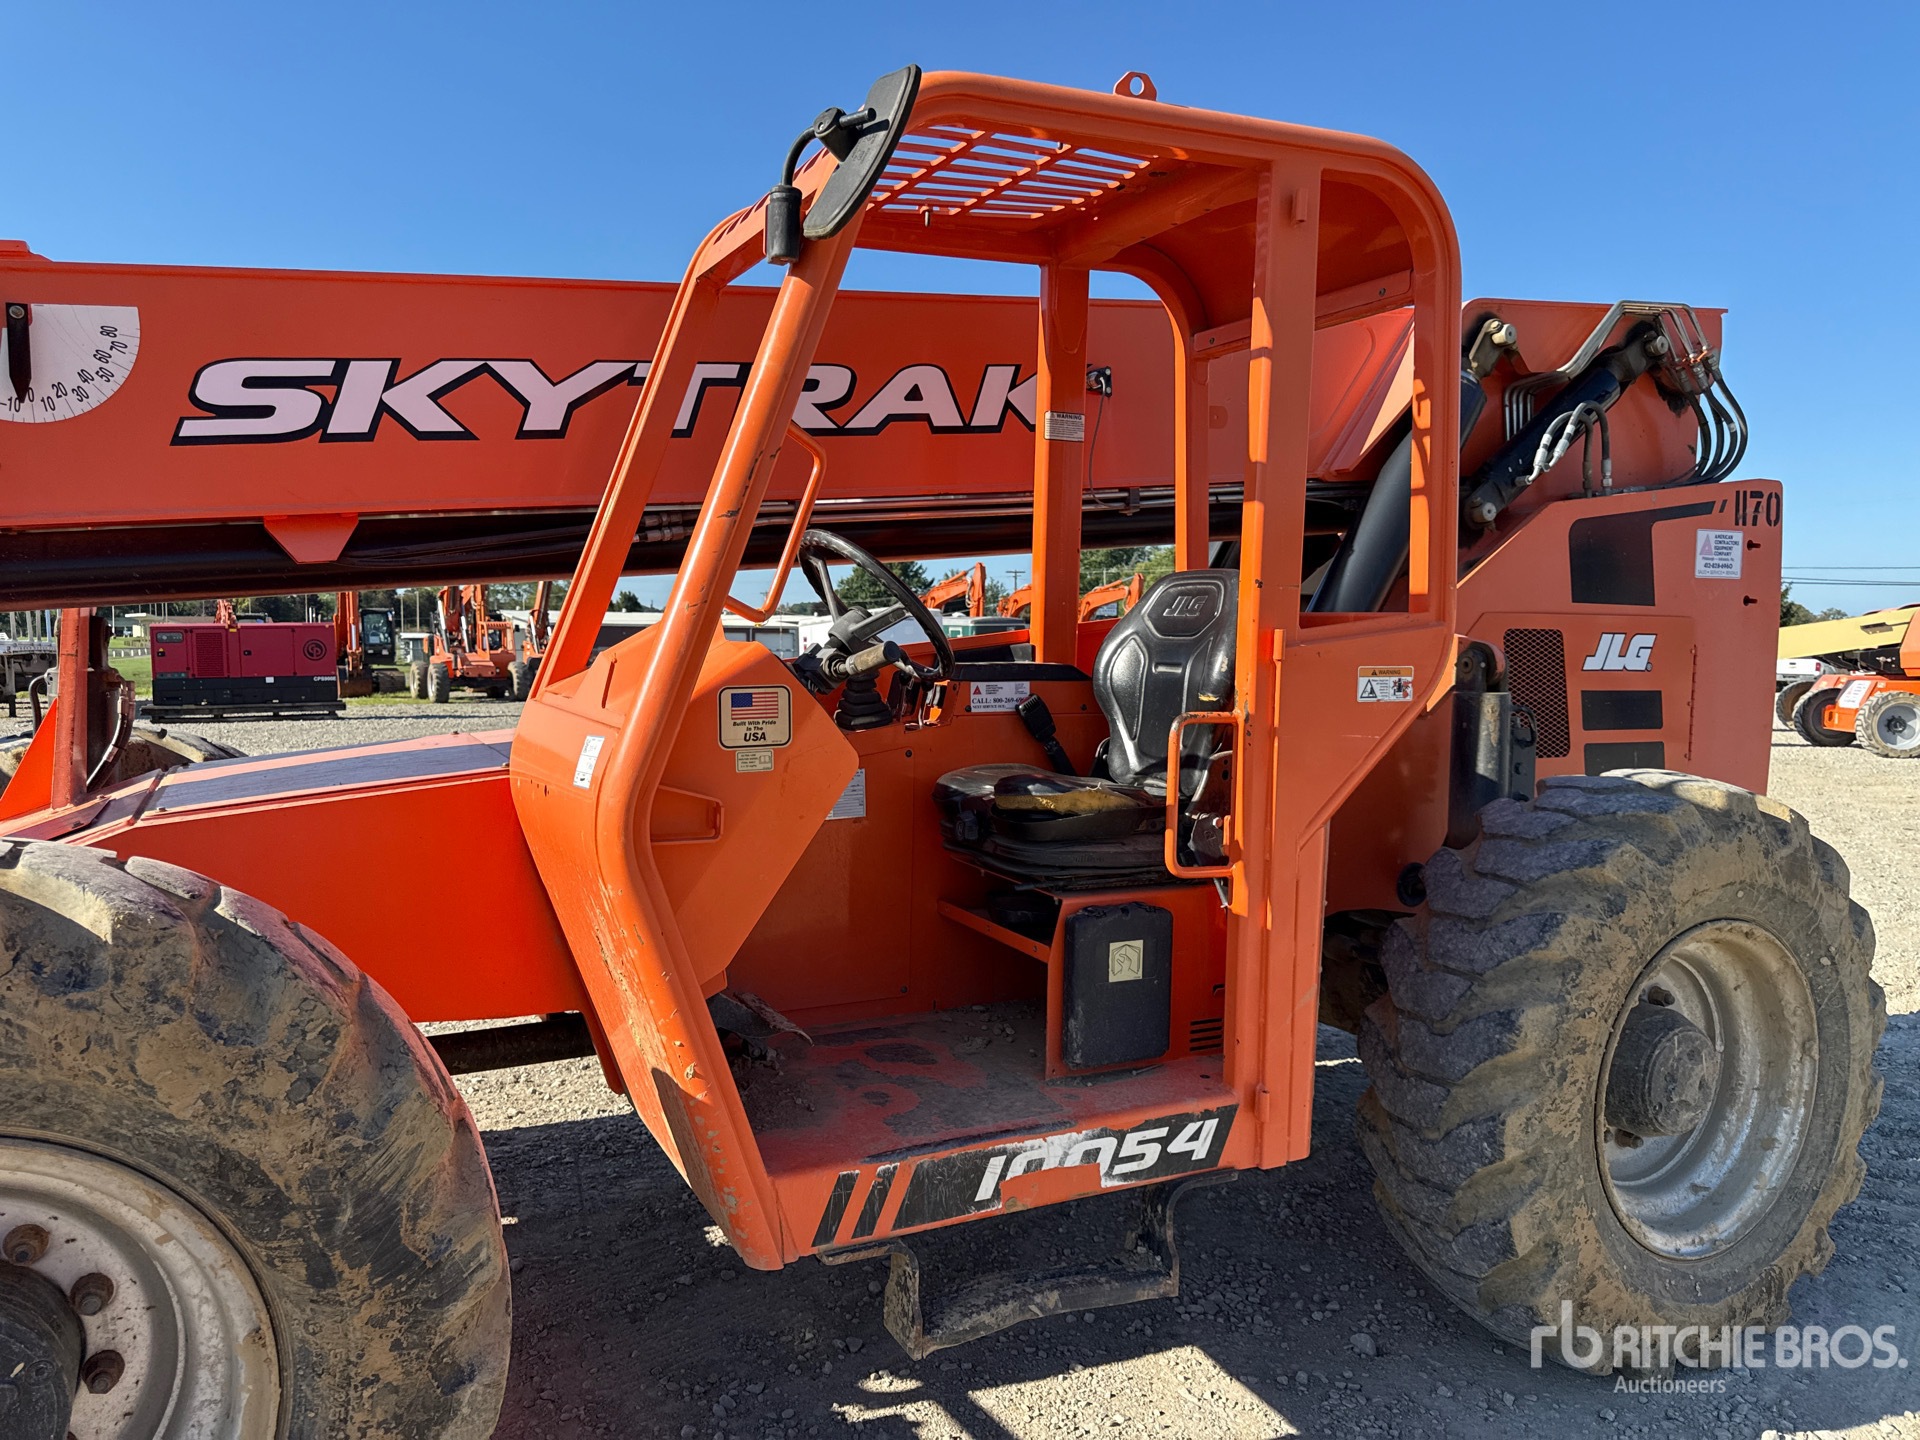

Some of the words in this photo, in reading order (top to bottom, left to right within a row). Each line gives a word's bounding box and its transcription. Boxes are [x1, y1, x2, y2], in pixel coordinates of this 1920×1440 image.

[100, 325, 118, 338] 80
[110, 341, 128, 354] 70
[93, 349, 112, 364] 60
[77, 369, 94, 384] 40
[95, 367, 114, 382] 50
[52, 382, 68, 398] 20
[72, 385, 89, 402] 30
[40, 396, 55, 412] 10
[1735, 490, 1780, 527] 1170
[1163, 595, 1208, 616] JLG
[1581, 632, 1657, 672] JLG
[743, 732, 767, 742] USA
